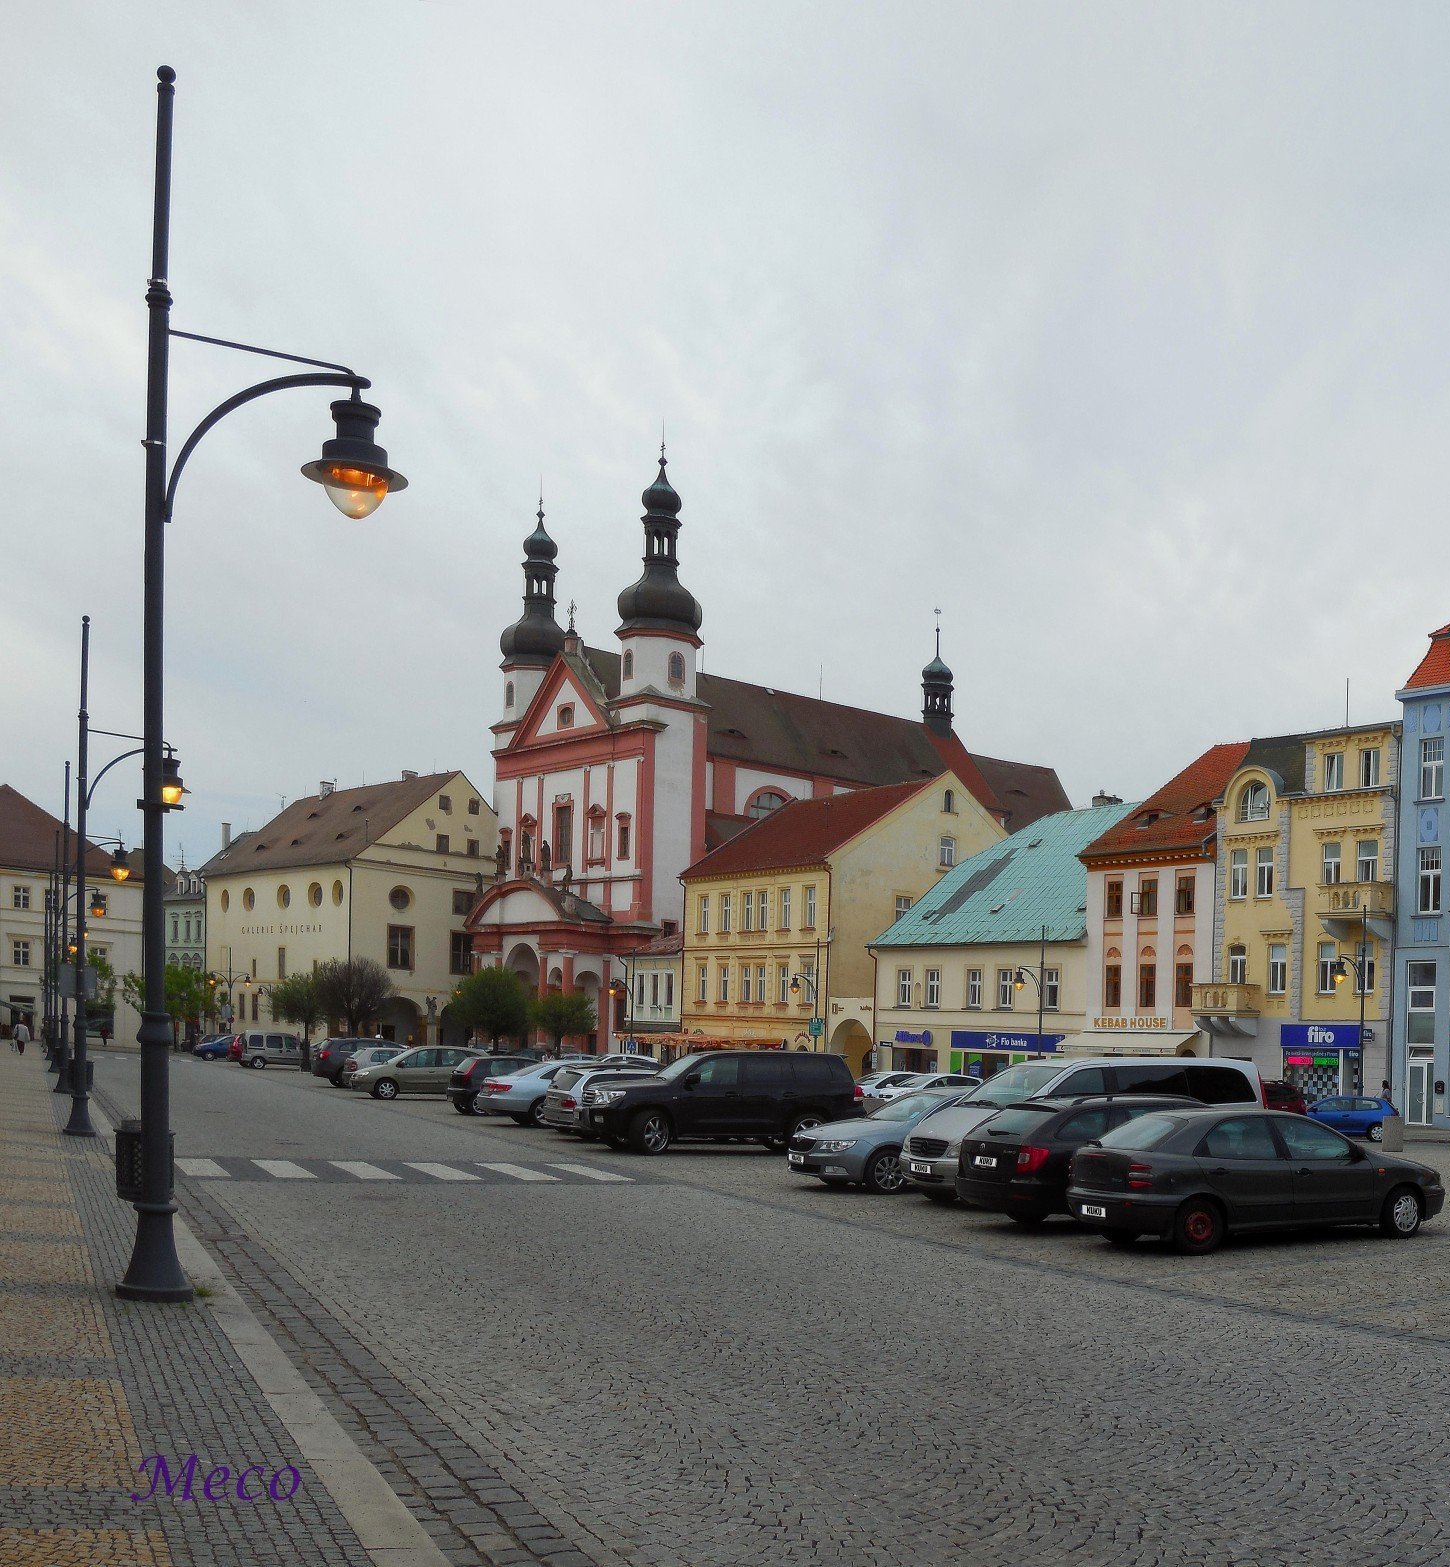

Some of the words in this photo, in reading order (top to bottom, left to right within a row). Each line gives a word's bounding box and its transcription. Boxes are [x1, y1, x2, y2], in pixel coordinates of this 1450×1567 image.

[241, 926, 274, 935] GALERIE
[279, 923, 322, 935] ŠPEJCHAR
[1093, 1017, 1127, 1028] KEBAB
[1129, 1017, 1167, 1028] HOUSE
[1307, 1026, 1335, 1043] firo
[1000, 1037, 1009, 1046] Fio
[1010, 1038, 1028, 1047] banka
[978, 1156, 994, 1166] KUKU
[914, 1164, 928, 1173] KUKU
[1086, 1205, 1103, 1216] KUKU
